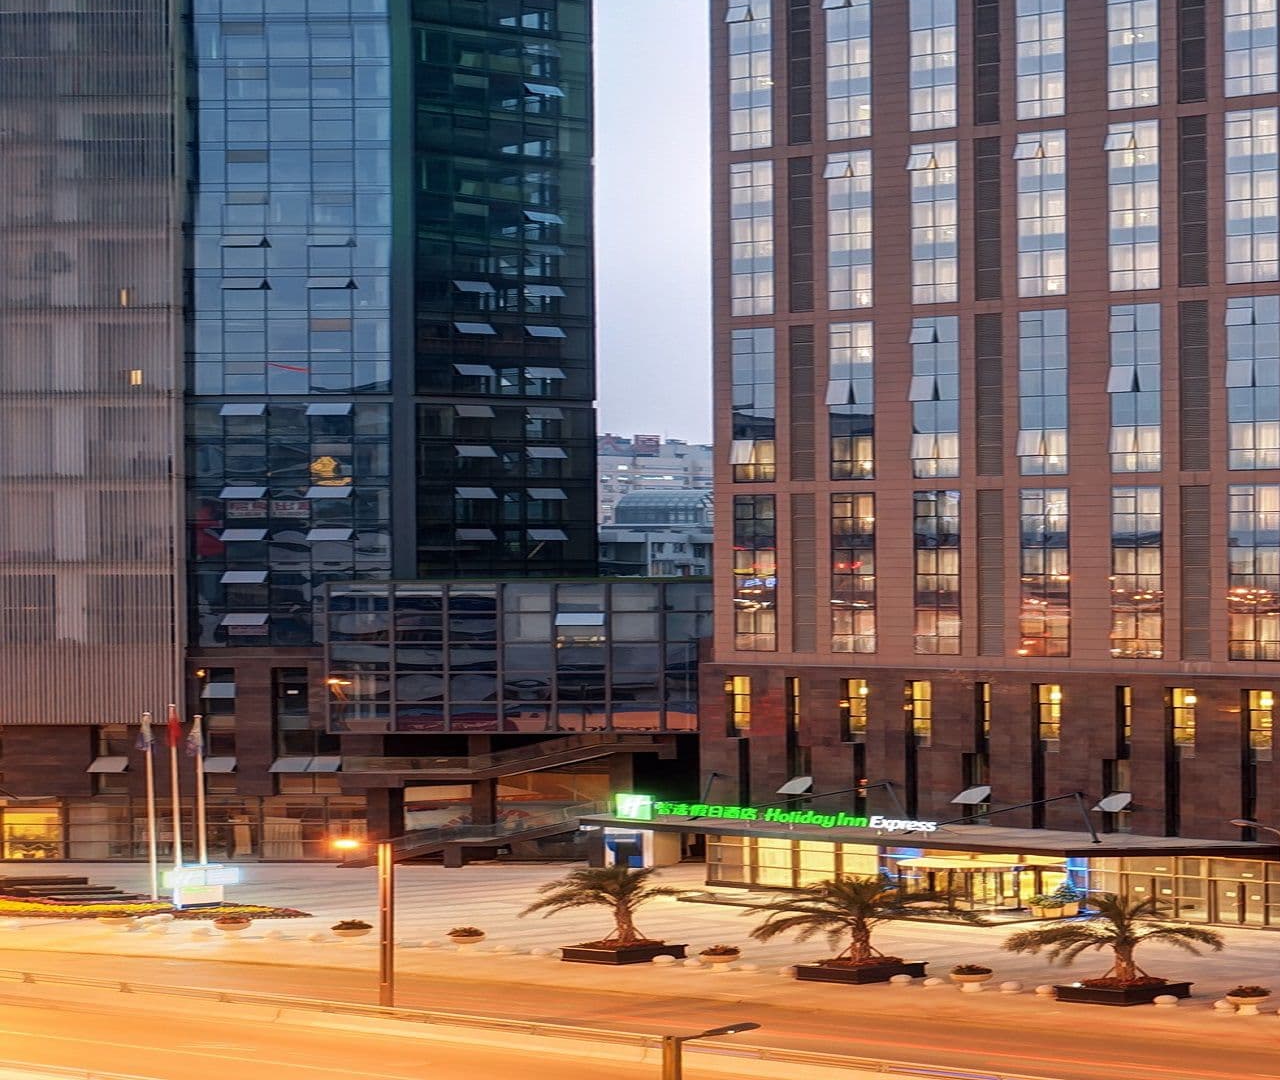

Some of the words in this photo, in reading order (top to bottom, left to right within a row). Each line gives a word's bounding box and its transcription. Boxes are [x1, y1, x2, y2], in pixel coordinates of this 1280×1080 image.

[764, 808, 835, 828] Holiday
[836, 812, 868, 827] Inn
[869, 815, 937, 832] Express
